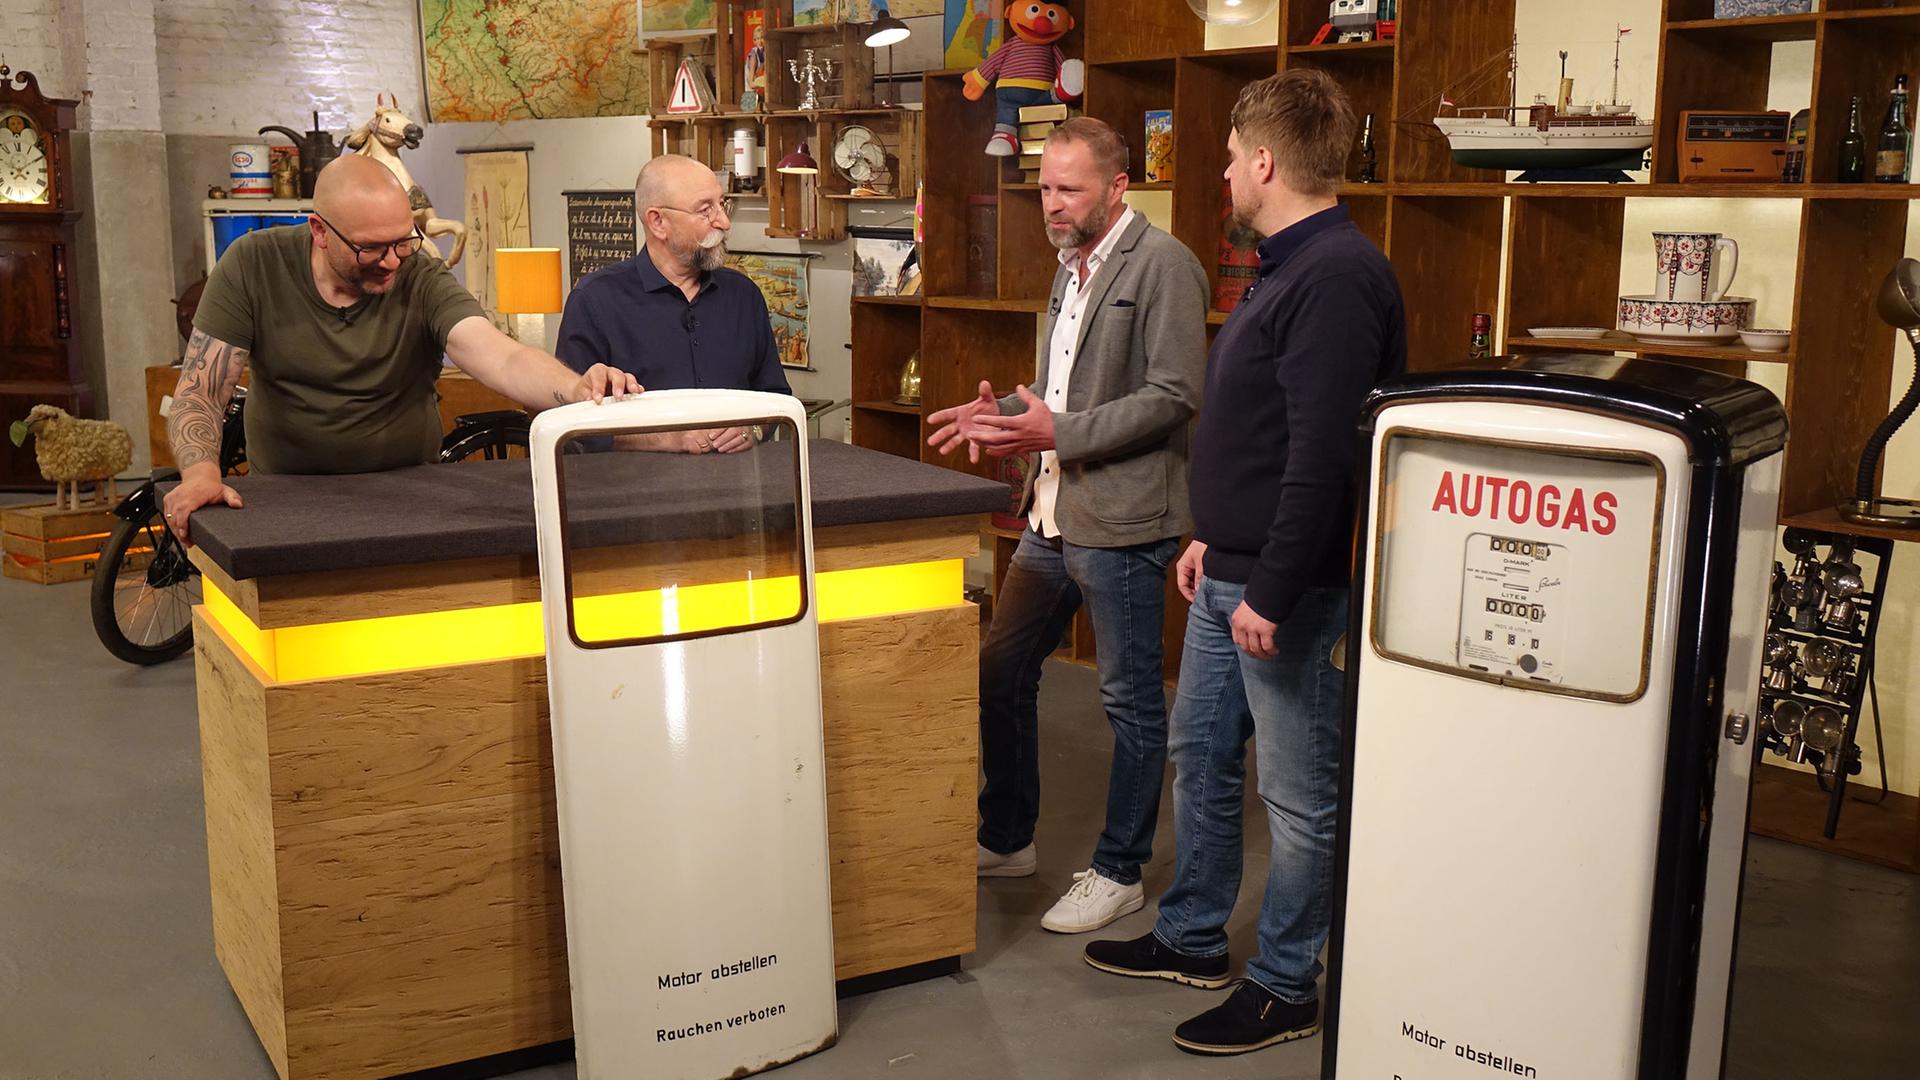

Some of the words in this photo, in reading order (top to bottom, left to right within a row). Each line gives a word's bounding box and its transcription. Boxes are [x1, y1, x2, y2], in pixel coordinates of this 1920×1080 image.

[1431, 470, 1618, 536] AUTOGAS
[1503, 558, 1530, 567] D-MARK
[1501, 592, 1527, 601] LITER
[658, 972, 703, 990] Motor
[711, 954, 777, 980] abstellen
[656, 1020, 723, 1043] Rauchen
[726, 1003, 786, 1028] verboten
[1401, 1021, 1447, 1050] Motor
[1455, 1044, 1537, 1079] abstellen
